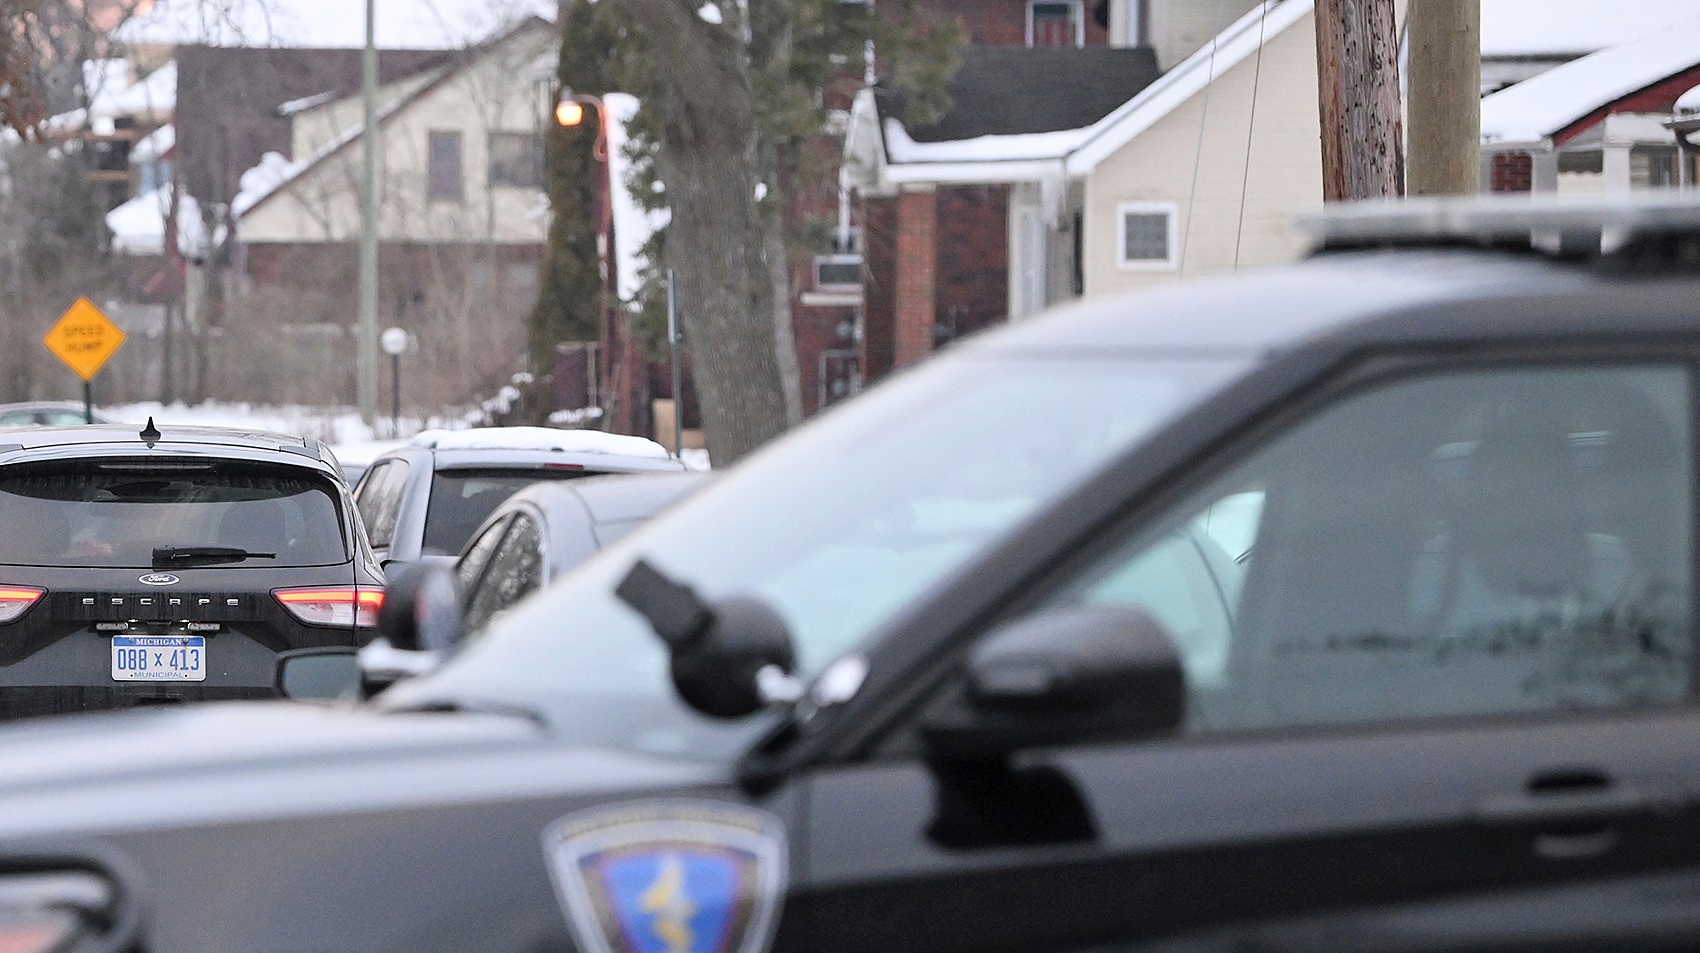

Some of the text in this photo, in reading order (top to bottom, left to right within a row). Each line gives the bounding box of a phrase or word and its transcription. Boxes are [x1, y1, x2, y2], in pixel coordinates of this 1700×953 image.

[82, 597, 239, 606] ESCAPE
[135, 638, 182, 646] MICHIGAN
[169, 648, 200, 671] 413
